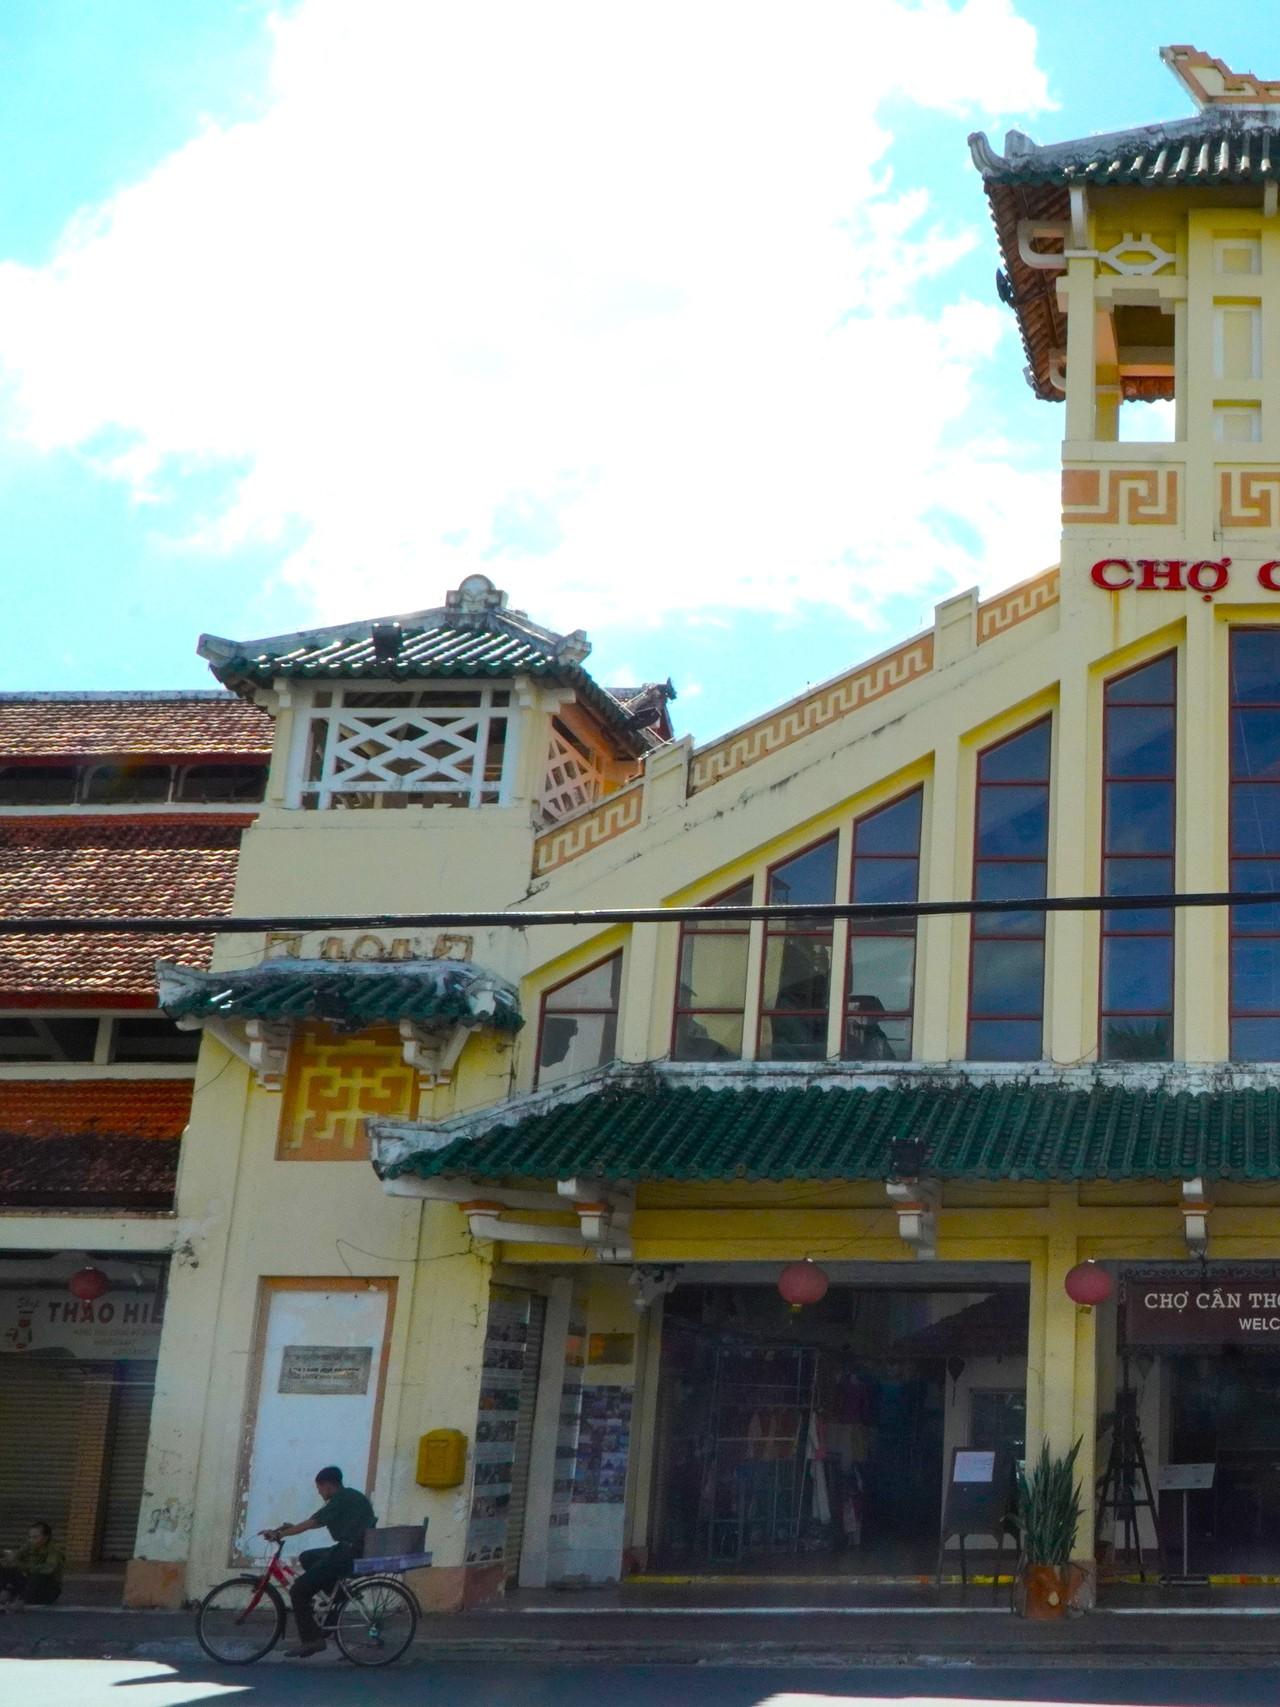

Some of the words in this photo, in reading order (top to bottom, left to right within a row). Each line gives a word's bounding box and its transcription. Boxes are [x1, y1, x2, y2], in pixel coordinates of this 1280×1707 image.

[1090, 556, 1232, 601] CHỢ
[1144, 1291, 1189, 1312] CHỢ
[1196, 1287, 1241, 1309] CẦN
